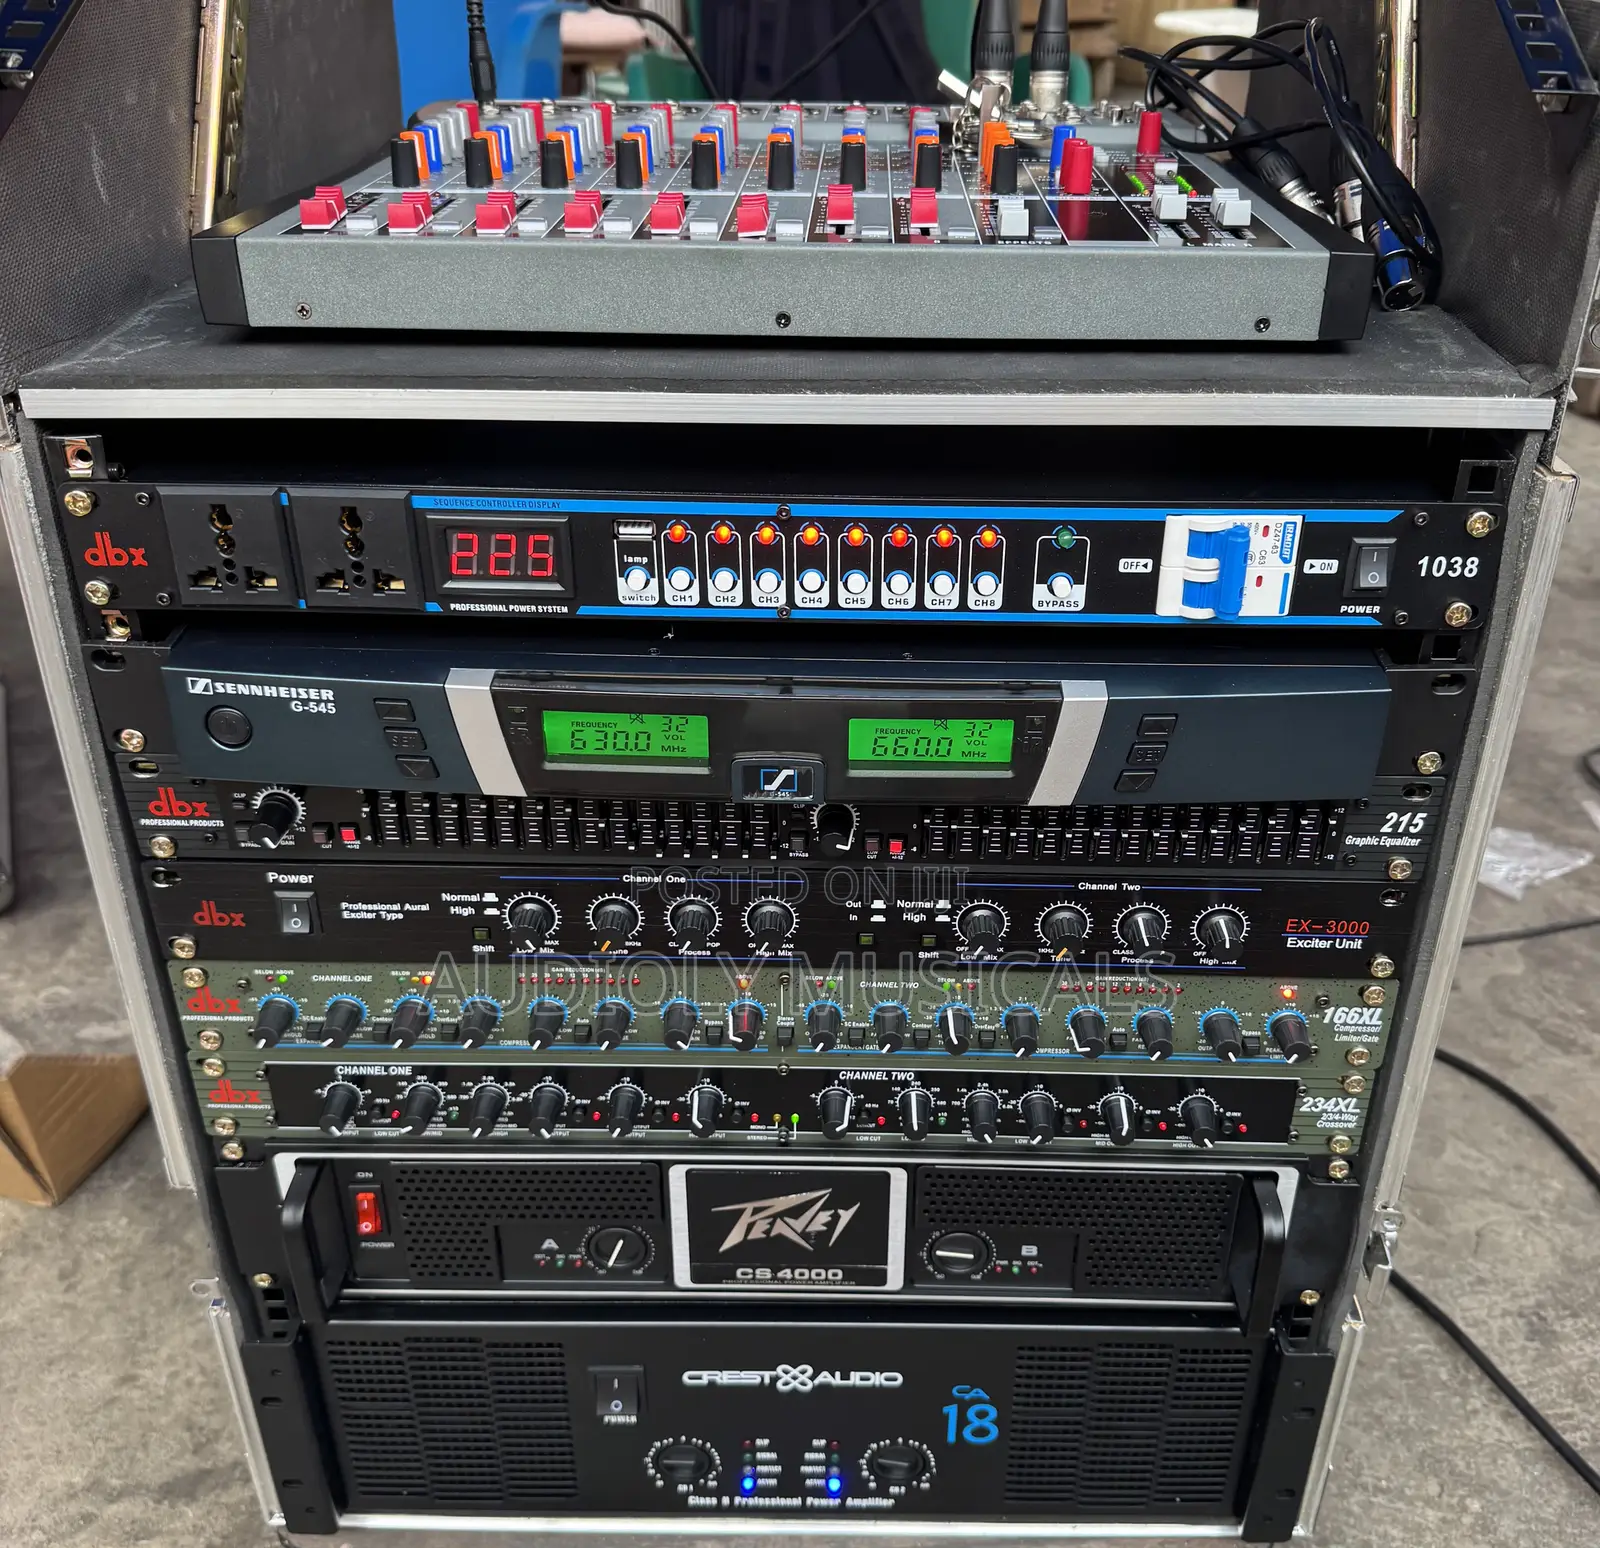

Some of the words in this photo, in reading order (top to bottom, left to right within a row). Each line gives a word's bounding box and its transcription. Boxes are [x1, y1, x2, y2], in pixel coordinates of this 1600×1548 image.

[433, 498, 475, 508] SEQUENCE
[476, 499, 527, 509] CONTROLLER
[528, 501, 561, 509] DISPLAY
[1271, 522, 1283, 555] DZ47-63
[84, 532, 148, 567] dbx
[451, 533, 553, 577] 225
[623, 554, 648, 564] lamp
[1258, 549, 1268, 565] C63
[1122, 561, 1142, 570] OFF
[1319, 562, 1334, 571] ON
[1417, 555, 1480, 578] 1038
[621, 593, 656, 602] switch
[671, 594, 693, 602] CH1
[715, 595, 737, 603] CH2
[758, 596, 780, 604] CH3
[801, 596, 823, 605] CH4
[844, 597, 866, 605] CH5
[887, 598, 909, 606] CH6
[930, 598, 952, 606] CH7
[974, 599, 996, 607] CH8
[1037, 600, 1080, 608] BYPASS
[450, 603, 508, 612] PROFESSIONAL
[509, 604, 537, 613] POWER
[537, 605, 569, 614] SYSTEM
[1339, 605, 1381, 614] POWER
[214, 682, 335, 701] SENNHEISER
[290, 701, 337, 714] G-545
[571, 720, 618, 729] FREQUENCY
[661, 716, 689, 733] 32
[963, 721, 993, 738] 32
[875, 727, 922, 736] FREQUENCY
[570, 729, 651, 752] 630.0
[661, 745, 687, 753] MHz
[871, 736, 953, 757] 660.0
[961, 750, 987, 759] MHz
[147, 787, 210, 817] dbx
[141, 818, 189, 827] PROFESSIONAL
[189, 819, 224, 827] PRODUCTS
[1380, 811, 1428, 834] 215
[1345, 834, 1380, 847] Graphic
[1379, 836, 1422, 847] Equalizer
[267, 871, 314, 884] Power
[622, 874, 662, 883] Channel
[666, 875, 686, 883] One
[1078, 883, 1117, 891] Channel
[1121, 883, 1141, 891] Two
[441, 892, 481, 902] Normal
[340, 902, 401, 911] Professional
[404, 903, 430, 911] Aural
[845, 900, 862, 908] Out
[896, 900, 934, 909] Normal
[193, 900, 246, 927] dbx
[342, 911, 377, 919] Exciter
[379, 911, 404, 921] Type
[450, 906, 476, 916] High
[903, 913, 926, 923] High
[1285, 918, 1370, 935] EX-3000
[1286, 937, 1333, 949] Exciter
[1335, 938, 1362, 949] Unit
[472, 944, 495, 953] Shift
[777, 949, 793, 957] Mix
[918, 951, 939, 959] Shift
[1199, 957, 1219, 965] High
[312, 974, 352, 982] CHANNEL
[859, 981, 899, 989] CHANNEL
[900, 981, 920, 989] TWO
[187, 986, 243, 1014] dbx
[1323, 1006, 1384, 1025] 166XL
[1334, 1024, 1383, 1034] Compressor/
[1334, 1033, 1380, 1043] Limiter/Gate
[334, 1065, 388, 1075] CHANNEL
[389, 1066, 413, 1075] ONE
[839, 1071, 889, 1081] CHANNEL
[891, 1071, 915, 1081] TWO
[208, 1079, 263, 1103] dbx
[1299, 1097, 1361, 1113] 234XL
[1321, 1113, 1358, 1122] 2/3/4-Way
[1316, 1120, 1357, 1128] Crossover
[711, 1188, 860, 1253] PEAVEY
[541, 1238, 560, 1250] A
[1021, 1244, 1038, 1257] B
[735, 1267, 772, 1279] CS
[776, 1267, 844, 1280] 4000
[681, 1369, 779, 1387] CREST
[812, 1370, 904, 1388] AUDIO
[951, 1384, 990, 1401] CA
[603, 1414, 638, 1425] POWER
[942, 1403, 999, 1445] 18
[687, 1495, 718, 1508] Class
[733, 1495, 802, 1508] Professional
[805, 1496, 841, 1509] Power
[845, 1496, 896, 1510] Amplifier
